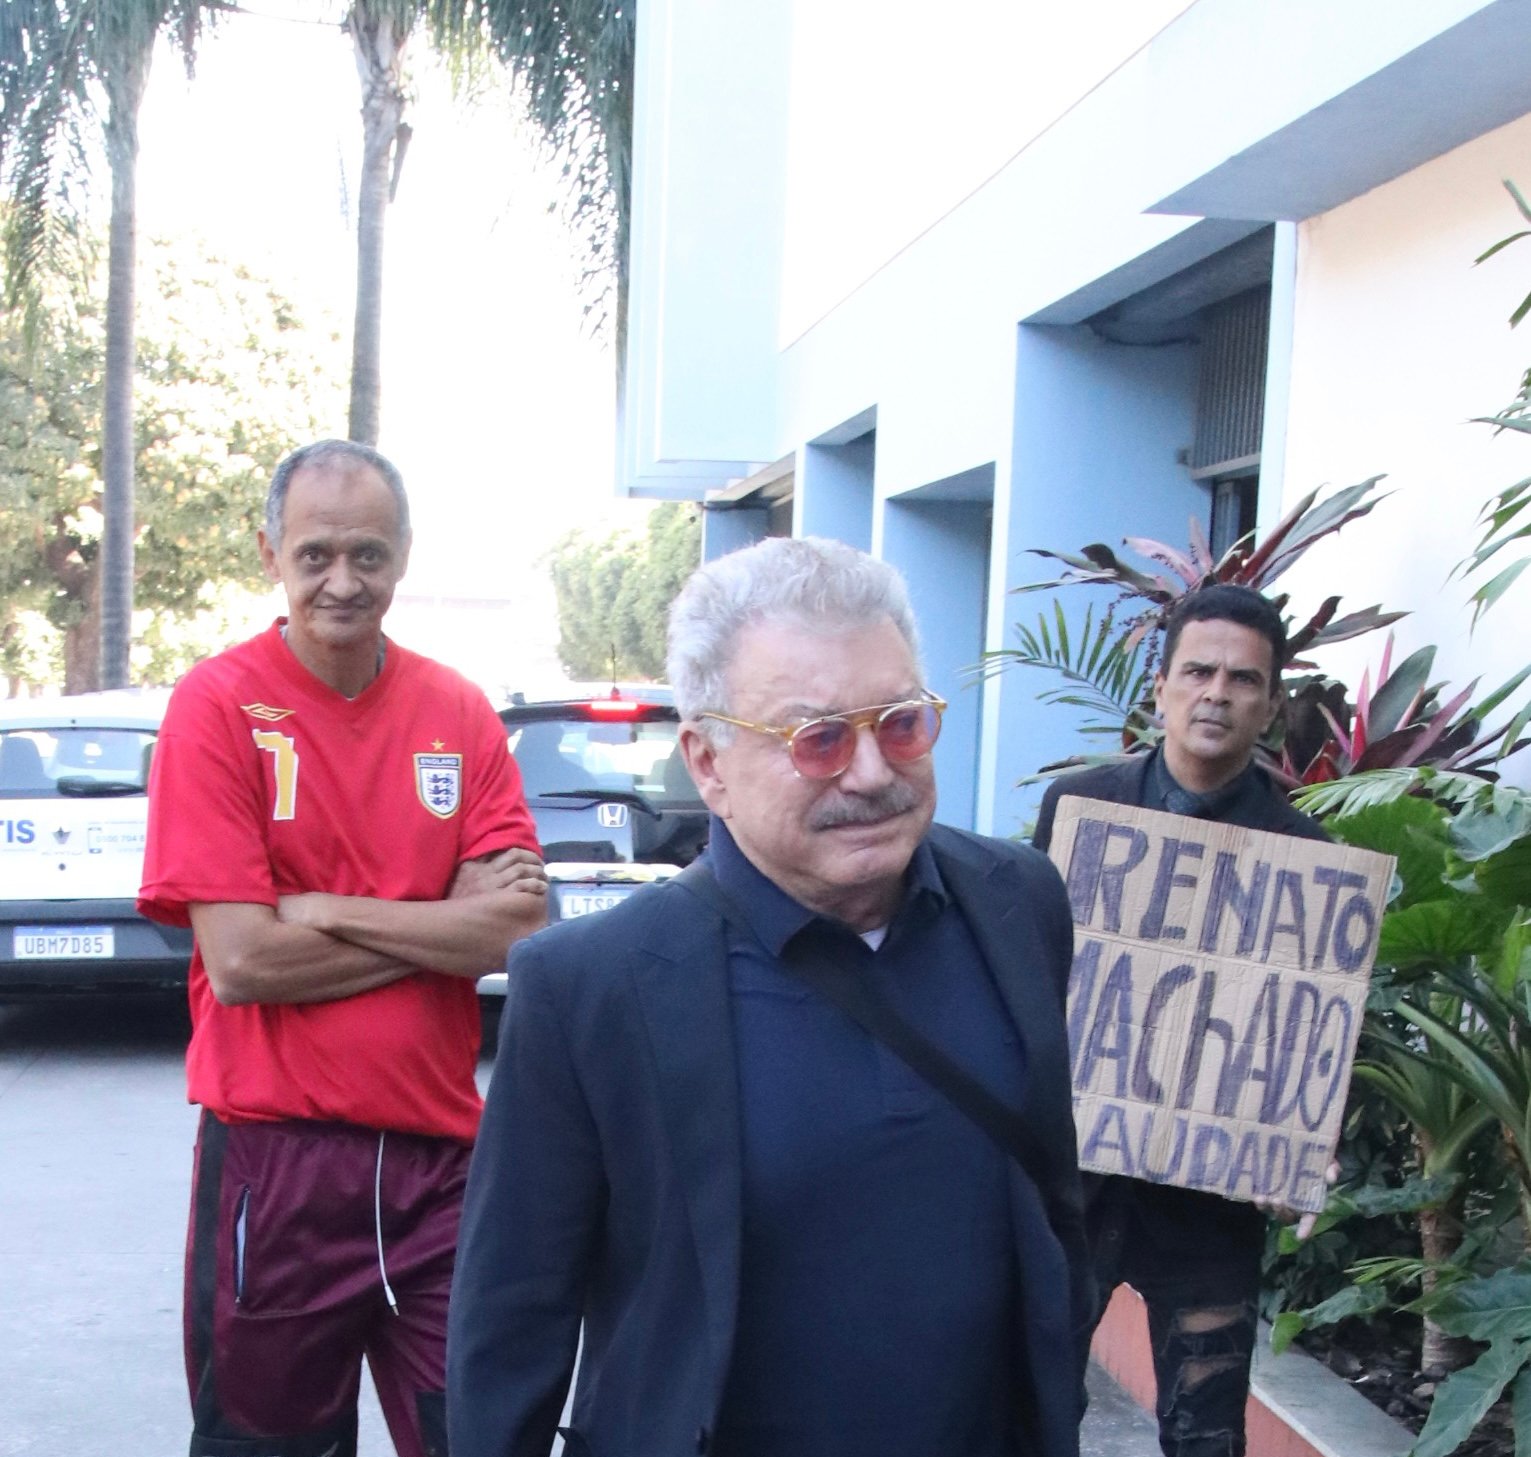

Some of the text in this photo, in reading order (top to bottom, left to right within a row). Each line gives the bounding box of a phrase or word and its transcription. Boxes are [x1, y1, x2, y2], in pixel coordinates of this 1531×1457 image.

[0, 819, 36, 844] IS
[571, 897, 623, 914] LTS8
[1066, 817, 1376, 975] RENATO
[24, 936, 104, 954] UBM7D85
[1073, 1099, 1328, 1206] AUDADE
